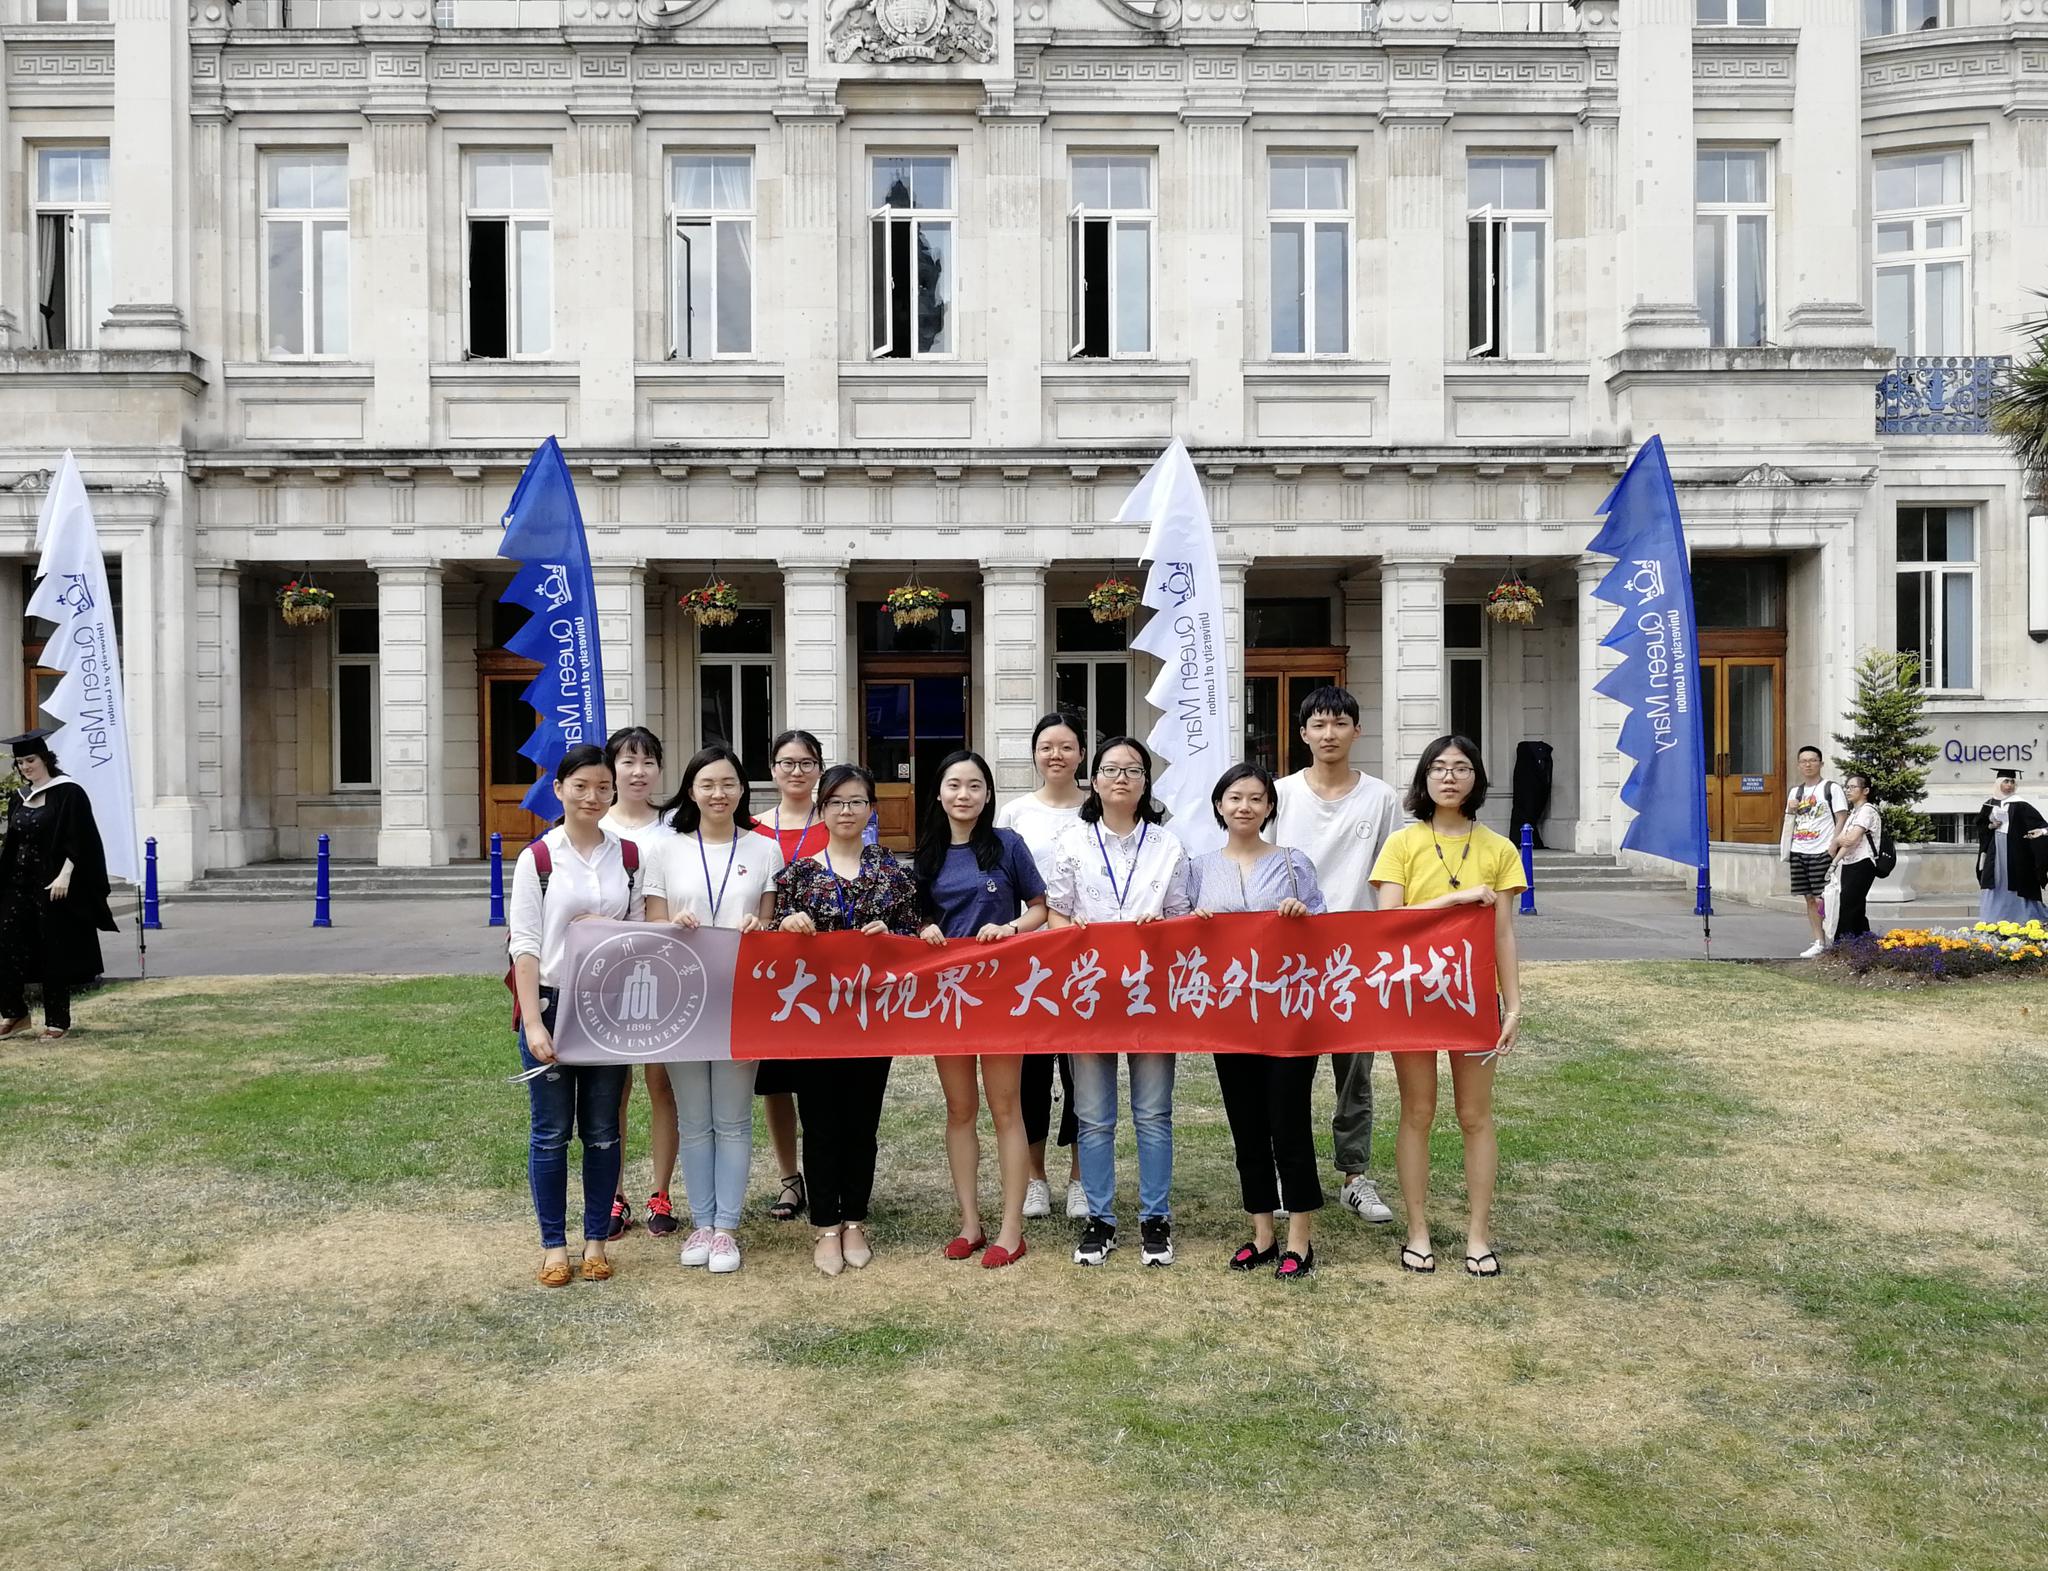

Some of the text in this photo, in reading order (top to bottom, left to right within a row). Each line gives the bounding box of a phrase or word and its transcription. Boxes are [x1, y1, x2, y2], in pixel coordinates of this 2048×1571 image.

[581, 990, 699, 1048] SICHUAN UNIVERSITY
[626, 1023, 652, 1032] 1896
